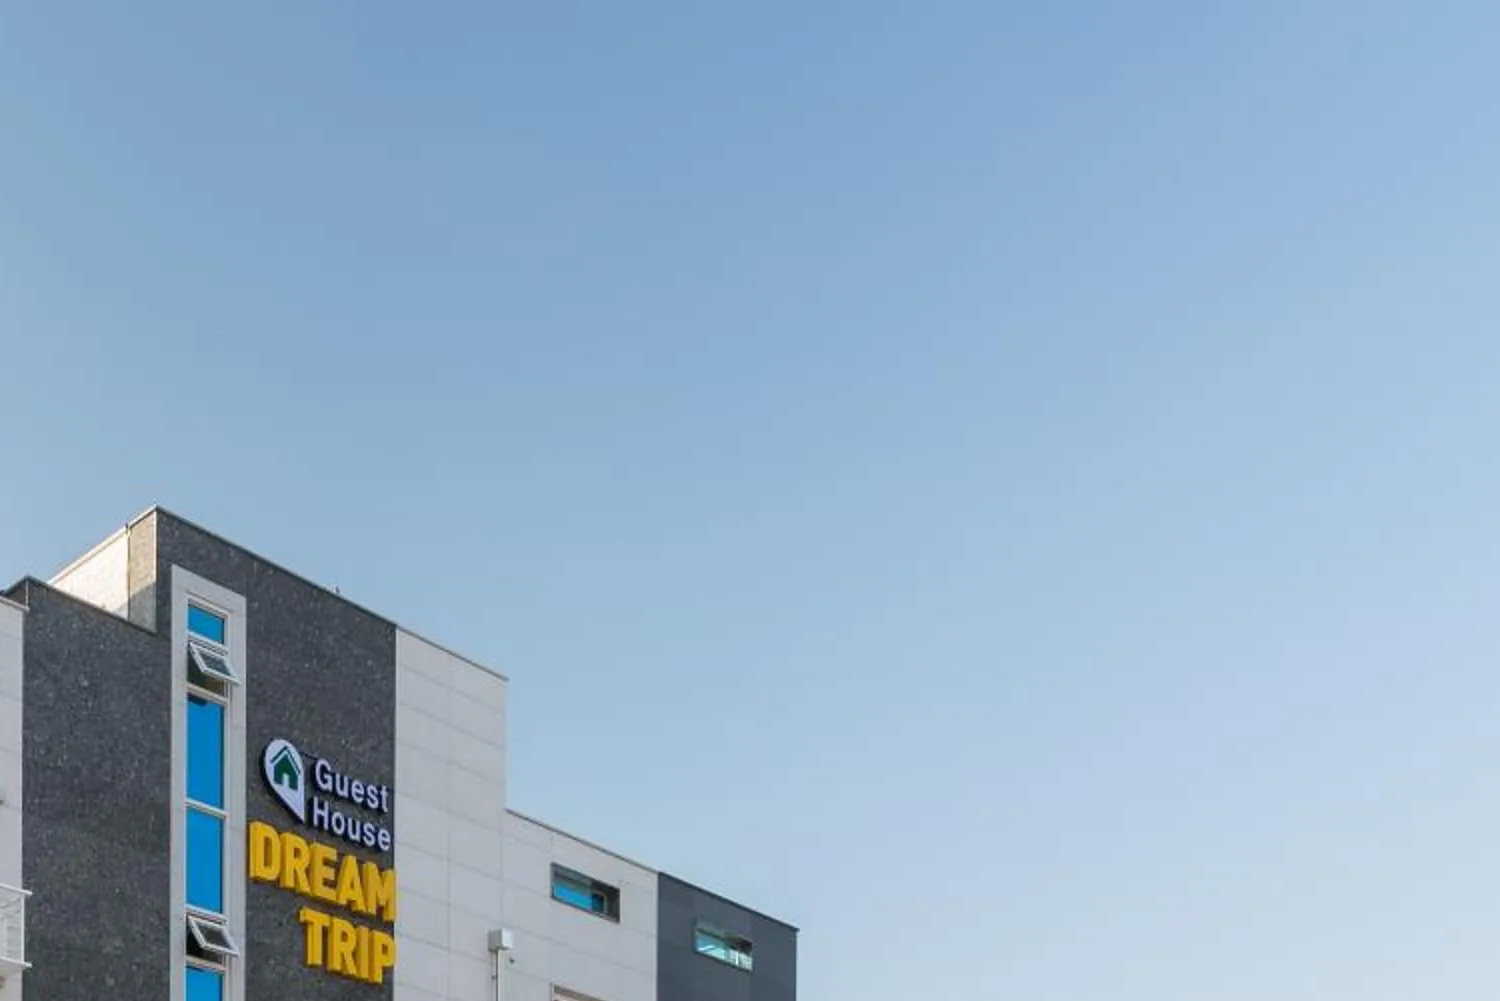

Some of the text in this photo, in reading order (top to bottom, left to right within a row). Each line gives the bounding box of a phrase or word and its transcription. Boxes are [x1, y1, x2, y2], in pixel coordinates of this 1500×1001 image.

[314, 759, 389, 812] Guest
[312, 797, 391, 851] House
[249, 821, 396, 922] DREAM
[298, 906, 396, 983] TRIP
